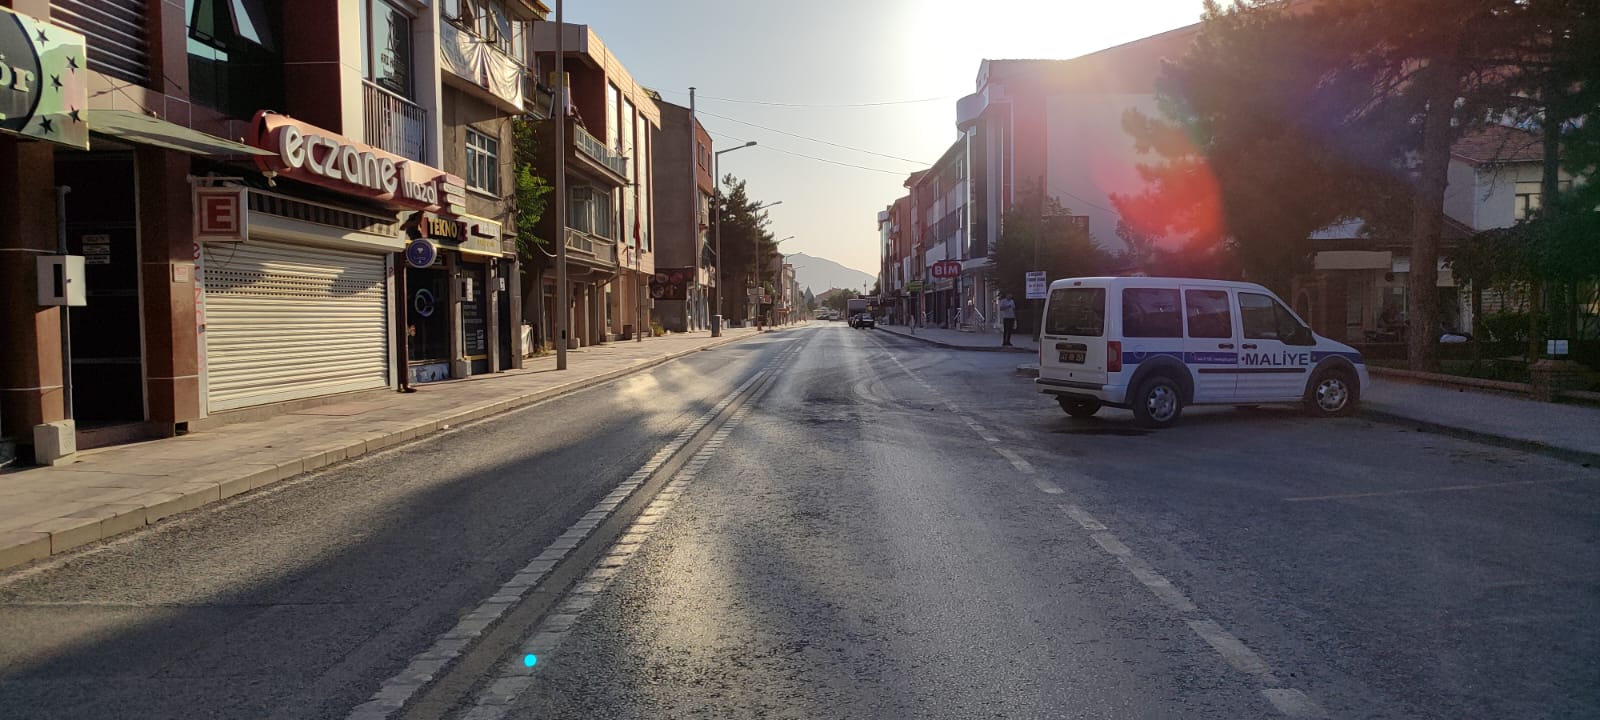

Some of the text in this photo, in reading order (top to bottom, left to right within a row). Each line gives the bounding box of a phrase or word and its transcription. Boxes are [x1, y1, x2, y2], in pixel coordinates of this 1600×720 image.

[280, 125, 397, 193] eczane
[204, 197, 235, 231] E
[935, 262, 958, 275] BİM
[1245, 350, 1308, 366] MALİYE
